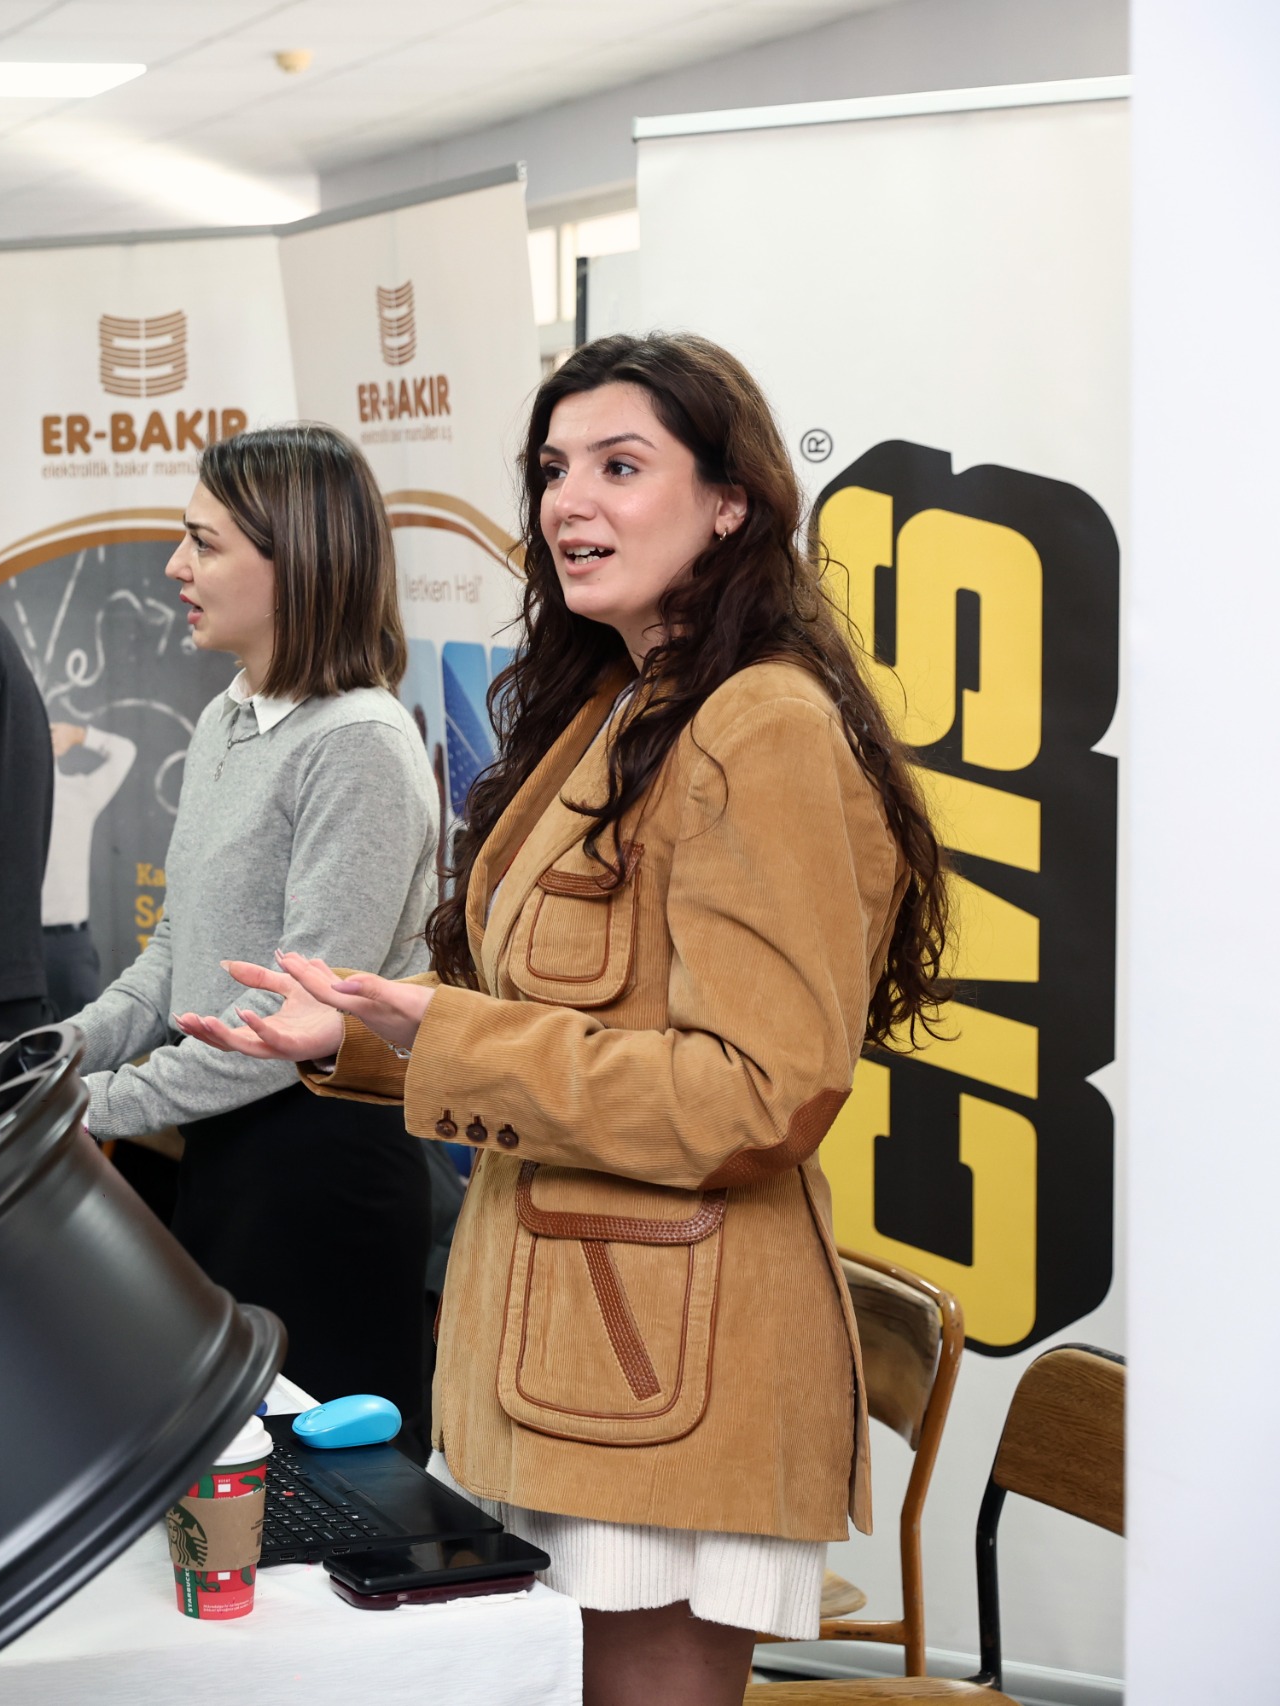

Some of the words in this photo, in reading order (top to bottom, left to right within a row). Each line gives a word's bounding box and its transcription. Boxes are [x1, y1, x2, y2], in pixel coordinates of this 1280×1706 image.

[357, 374, 451, 423] ER-BAKIR
[41, 408, 248, 455] ER-BAKIR
[816, 485, 1043, 1348] CMS
